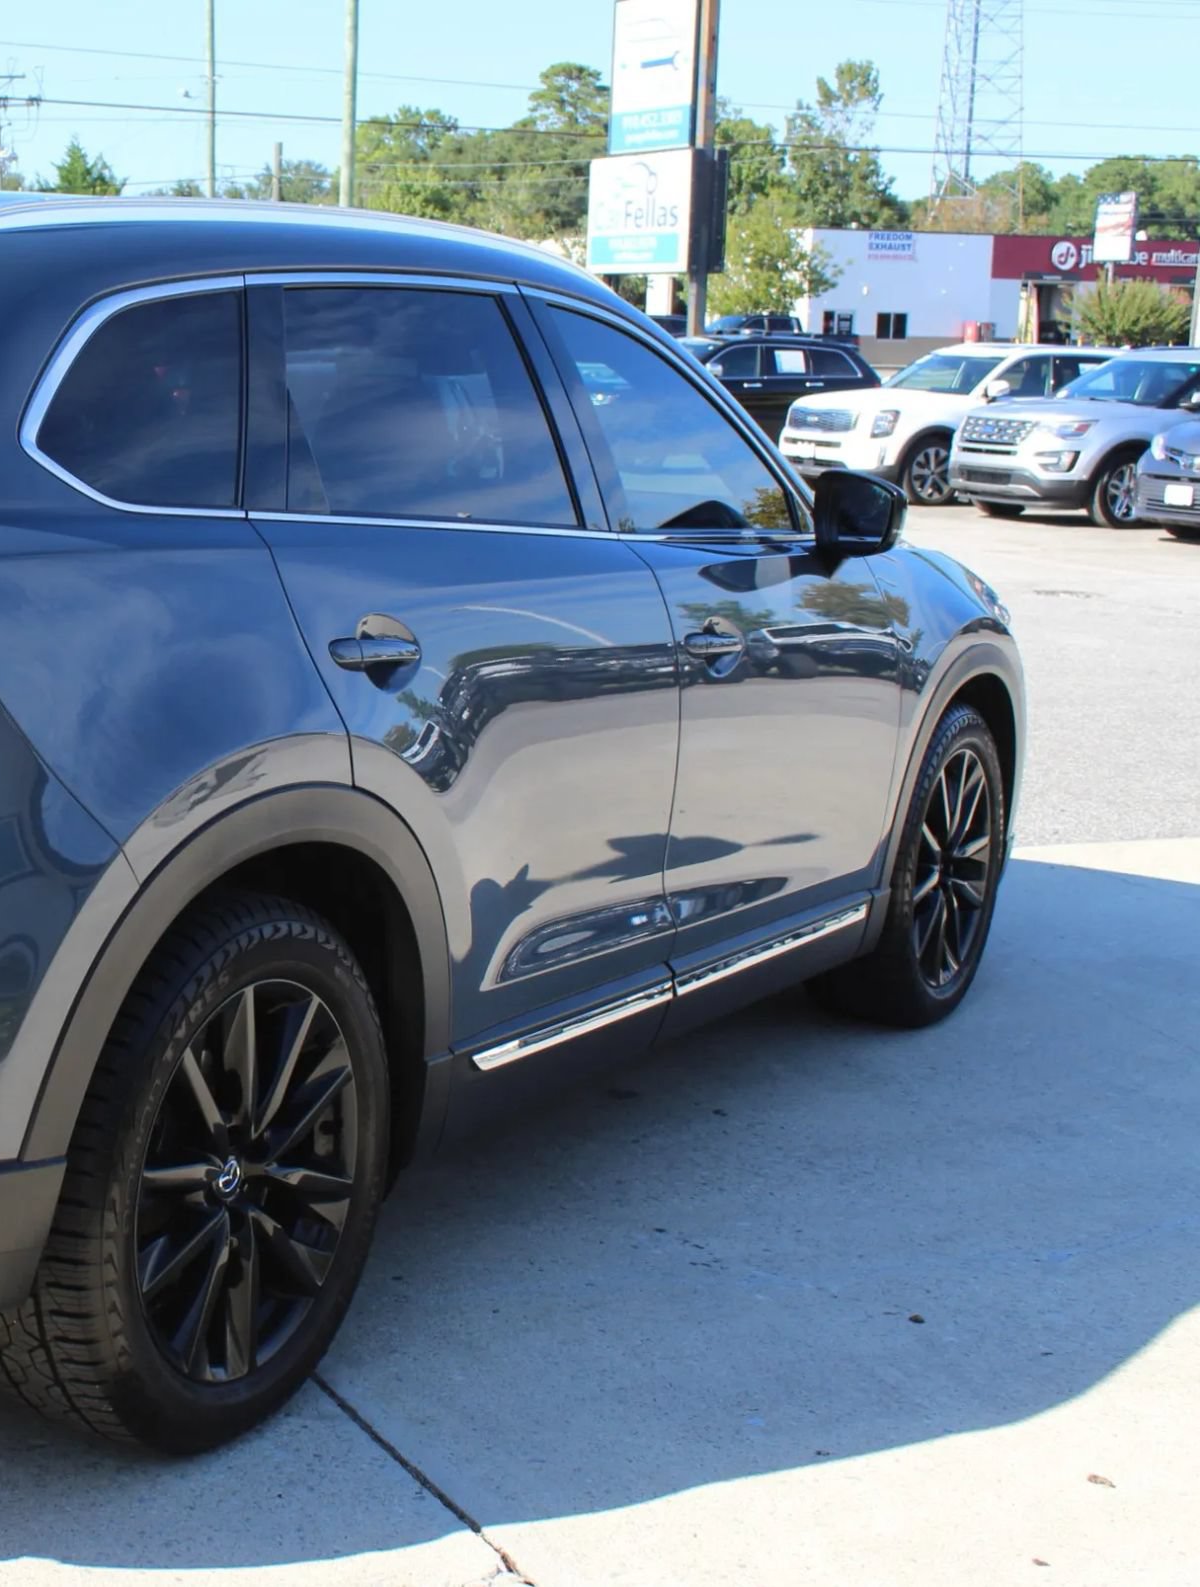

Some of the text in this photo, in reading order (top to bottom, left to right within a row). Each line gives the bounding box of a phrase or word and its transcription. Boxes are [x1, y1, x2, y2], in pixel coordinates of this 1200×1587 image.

[624, 200, 679, 228] Fellas
[868, 231, 912, 241] FREEDOM
[868, 242, 912, 252] EXHAUST
